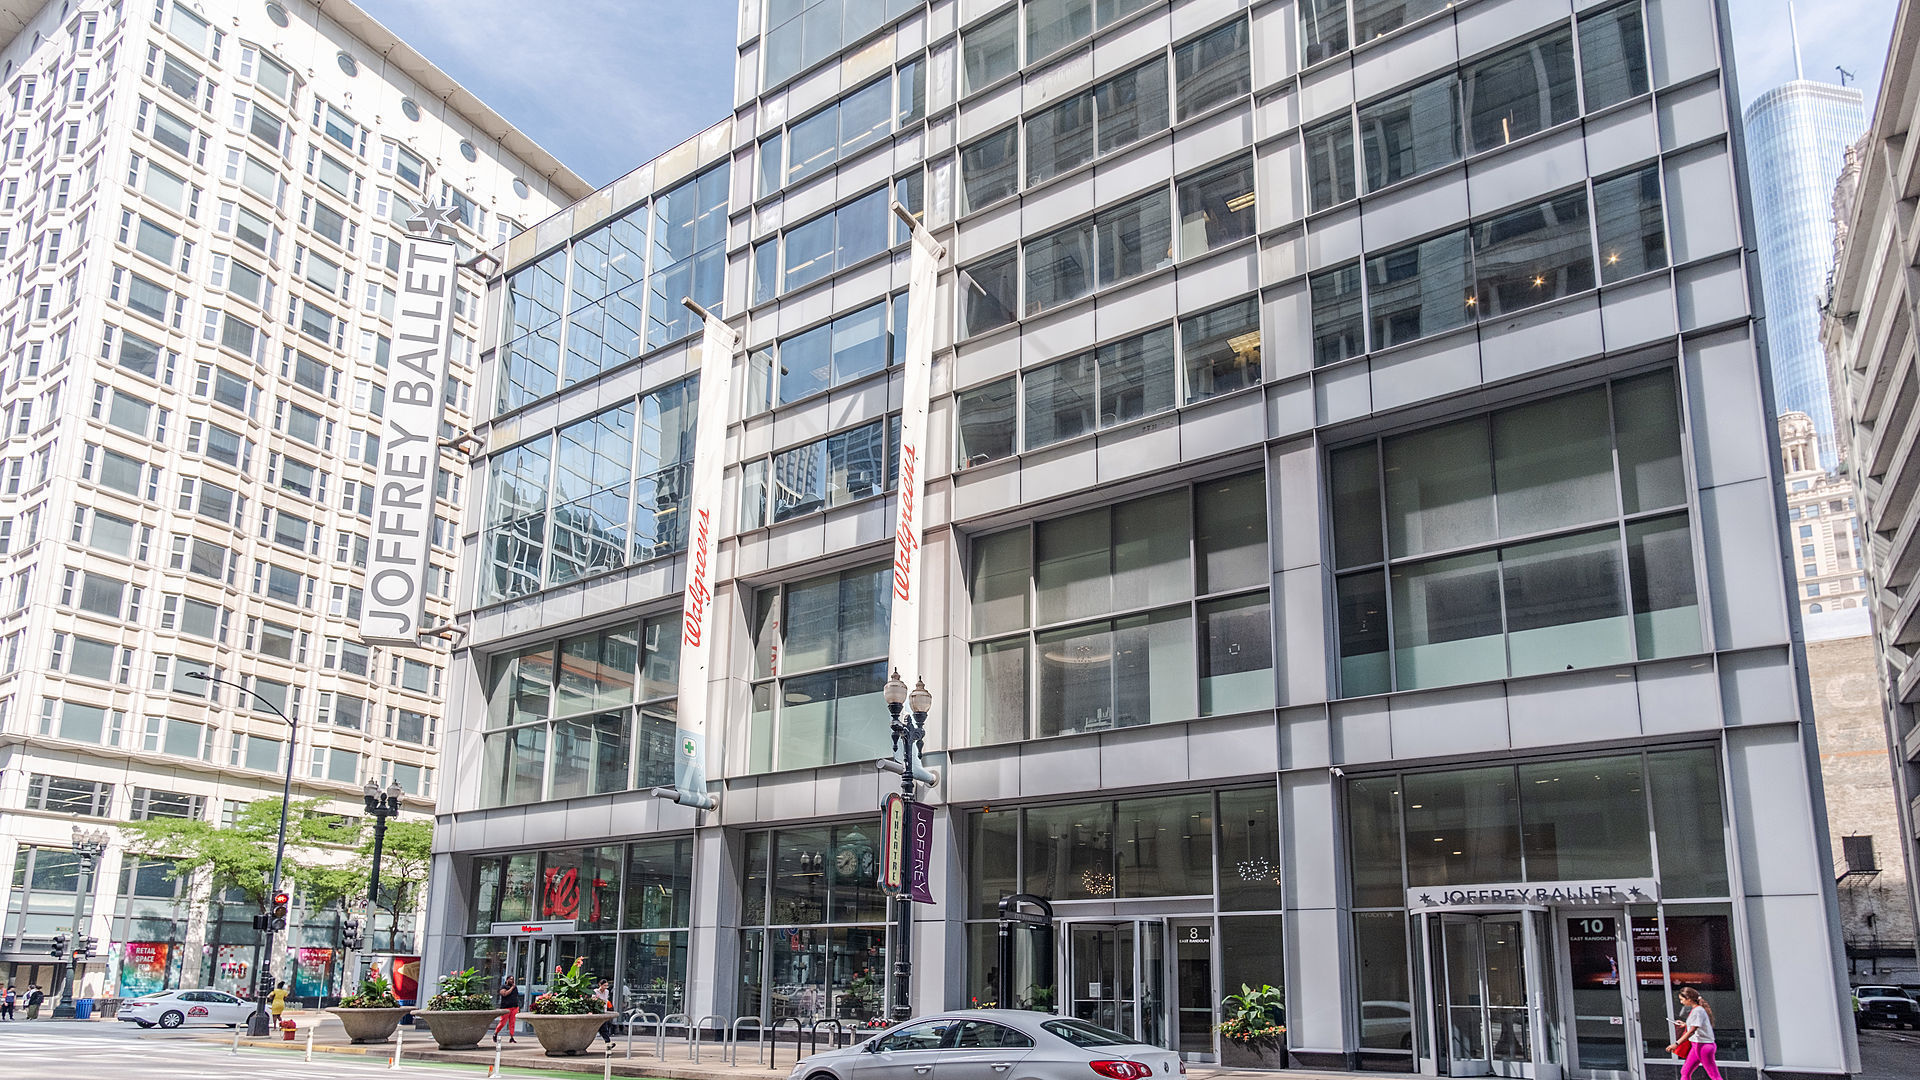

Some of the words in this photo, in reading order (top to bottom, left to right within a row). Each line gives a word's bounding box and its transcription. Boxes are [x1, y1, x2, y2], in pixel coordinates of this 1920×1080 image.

[392, 243, 448, 408] BALLET
[369, 421, 429, 635] JOFFREY
[893, 443, 919, 602] Walgreens
[683, 507, 711, 648] Walgreens
[914, 812, 928, 894] JOFFREY
[1439, 889, 1531, 905] JOFFREY
[1535, 886, 1617, 902] BALLET
[1190, 927, 1198, 939] 8
[1579, 919, 1604, 933] 10
[135, 947, 156, 955] RETAIL
[135, 955, 155, 963] SPACE
[137, 963, 151, 971] FOR
